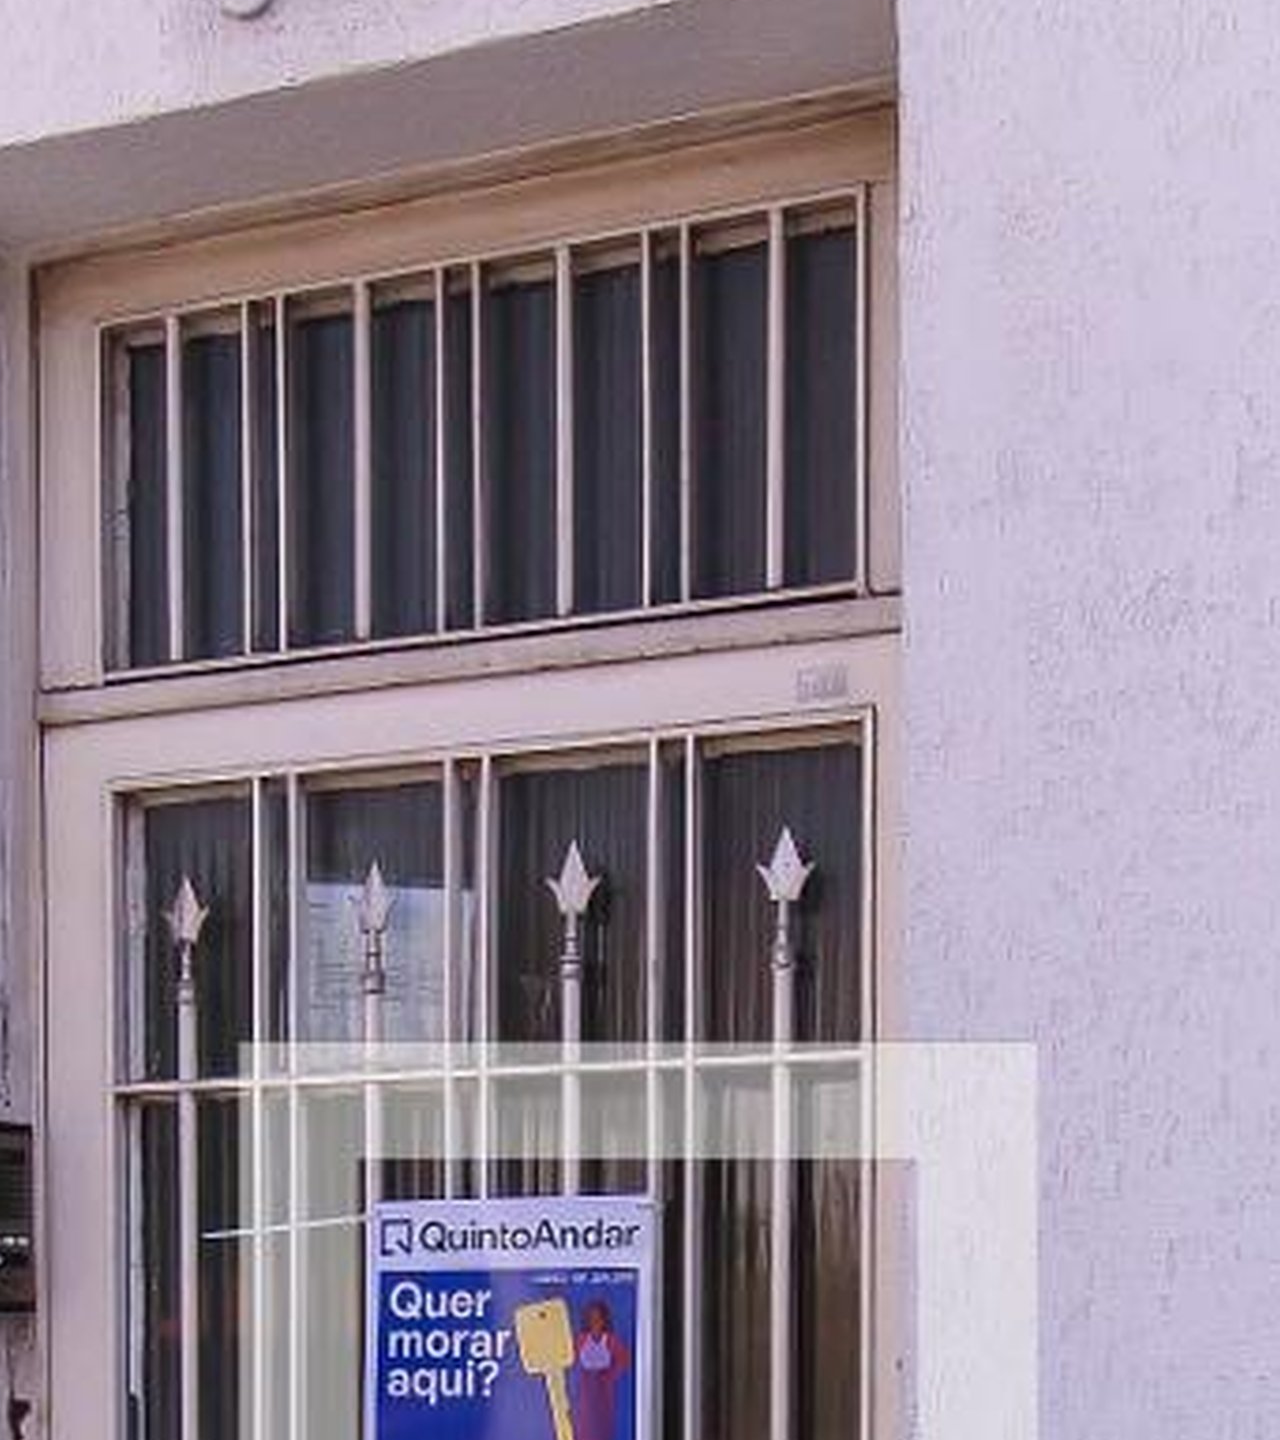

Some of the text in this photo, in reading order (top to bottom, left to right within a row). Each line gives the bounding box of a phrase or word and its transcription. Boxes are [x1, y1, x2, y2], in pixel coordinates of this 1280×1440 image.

[420, 1218, 641, 1252] QuintoAndar
[390, 1281, 491, 1319] Quer
[388, 1328, 511, 1358] morar
[387, 1360, 500, 1405] aqui?
